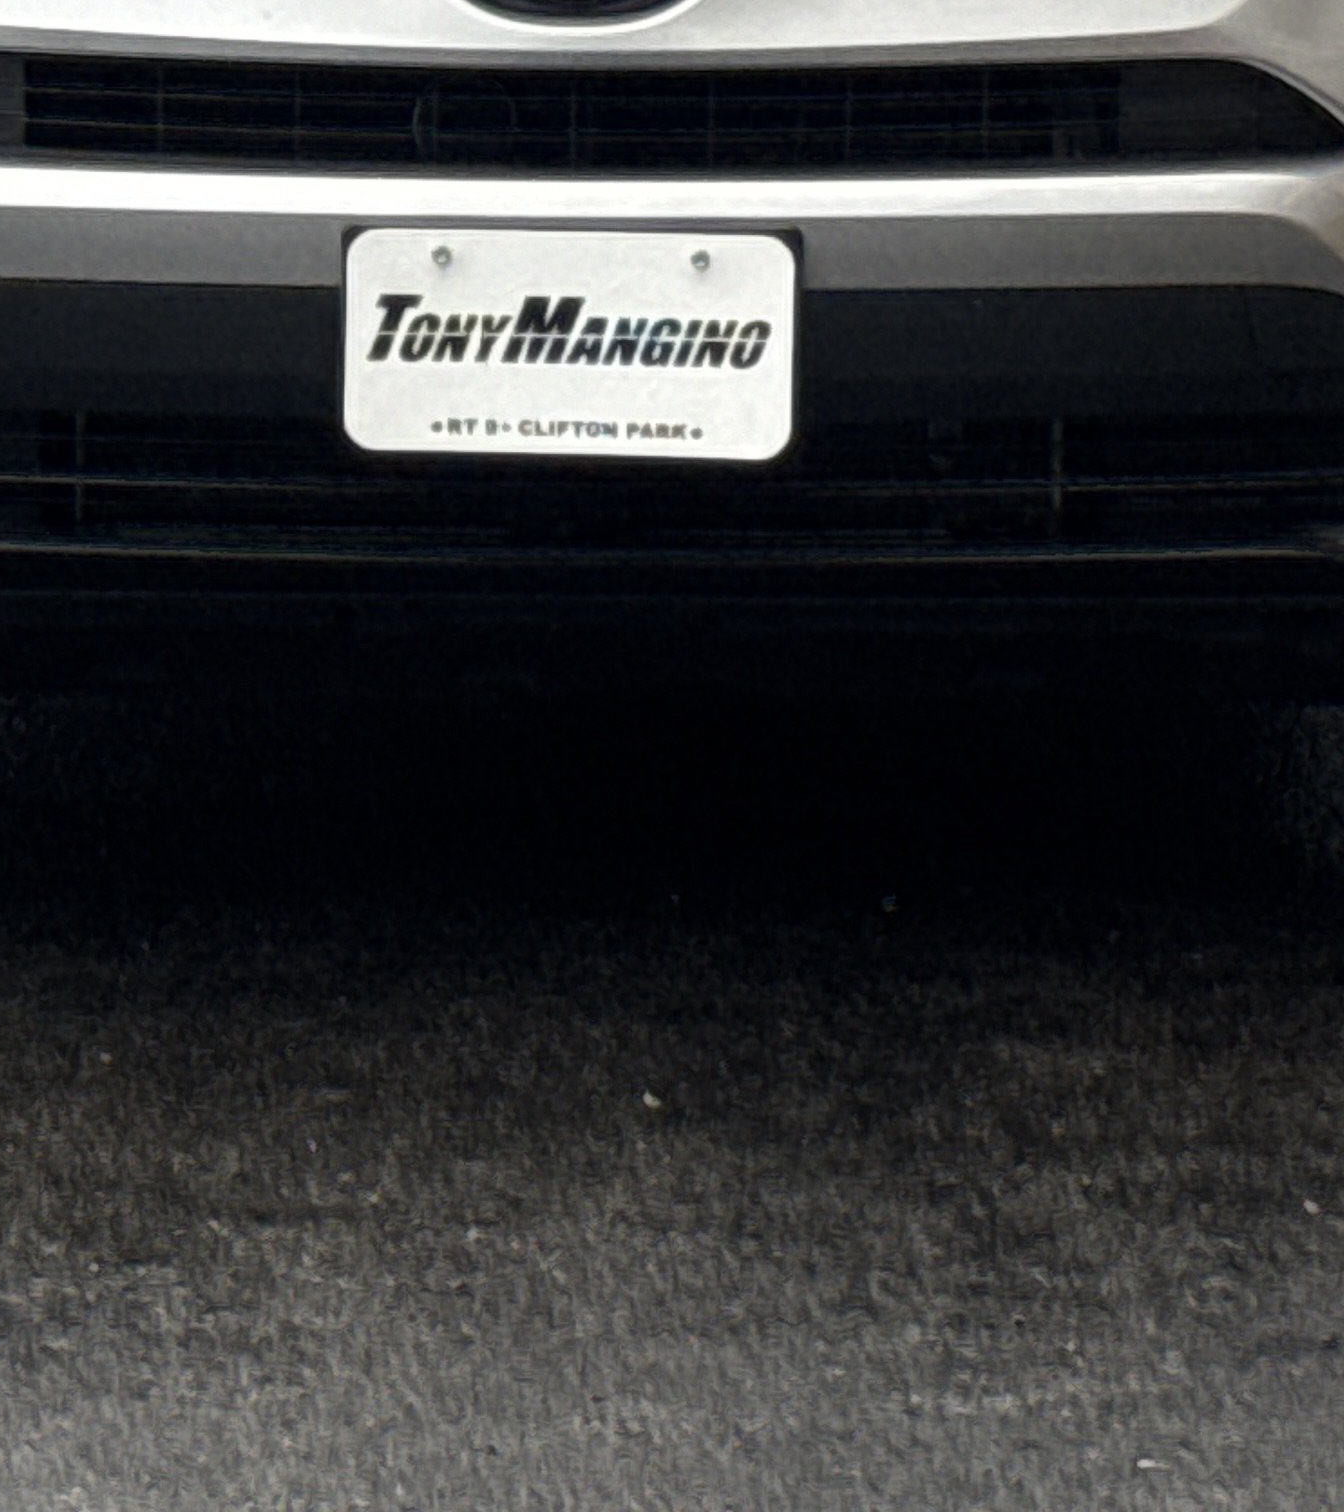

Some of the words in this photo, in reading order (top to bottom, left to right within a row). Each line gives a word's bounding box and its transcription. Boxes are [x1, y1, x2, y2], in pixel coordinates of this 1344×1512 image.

[446, 417, 479, 436] RT
[517, 419, 619, 439] CLIFTON
[626, 422, 688, 440] PARK
